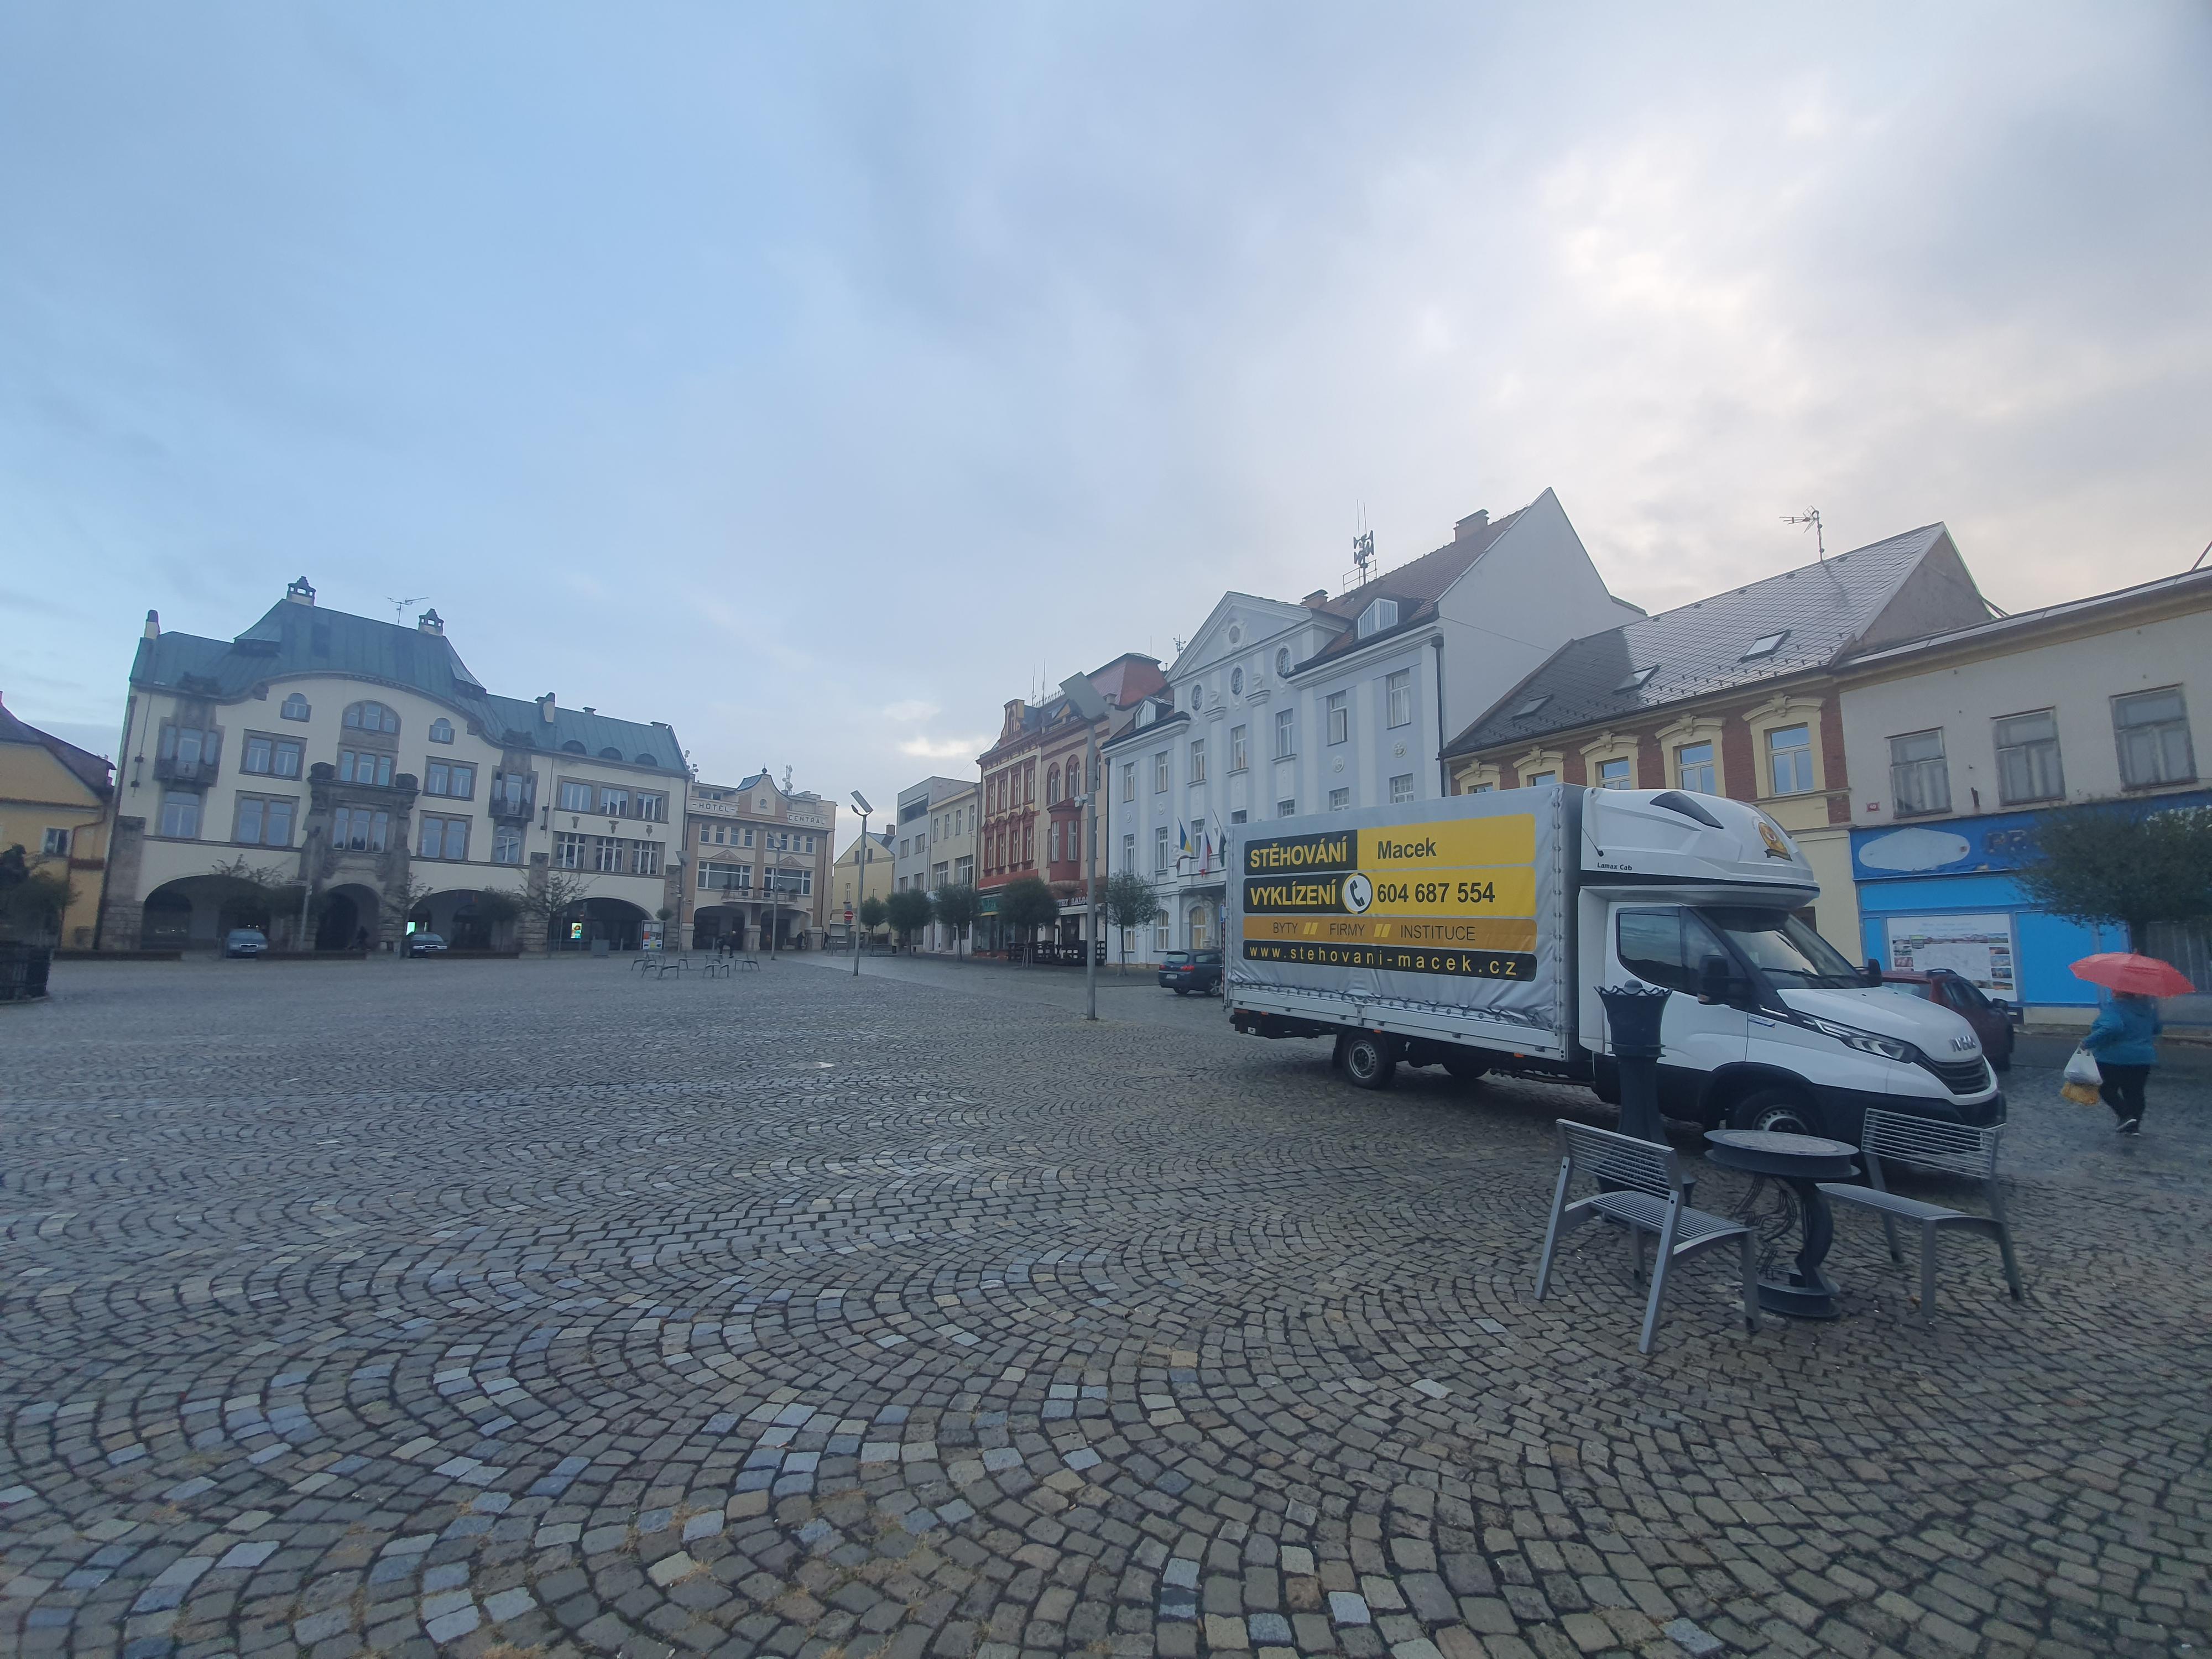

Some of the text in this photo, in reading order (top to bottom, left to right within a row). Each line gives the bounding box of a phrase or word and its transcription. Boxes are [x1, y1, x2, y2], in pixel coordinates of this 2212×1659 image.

[789, 815, 826, 825] CENTRAL
[1250, 836, 1437, 868] STĚHOVÁNÍ Macek
[1250, 879, 1336, 906] VYKLÍZENÍ
[1377, 881, 1495, 903] 604 687 554
[1273, 922, 1475, 941] BYTY FIRMY INSTITUCE
[1249, 946, 1517, 975] www.stehovani-macek.cz
